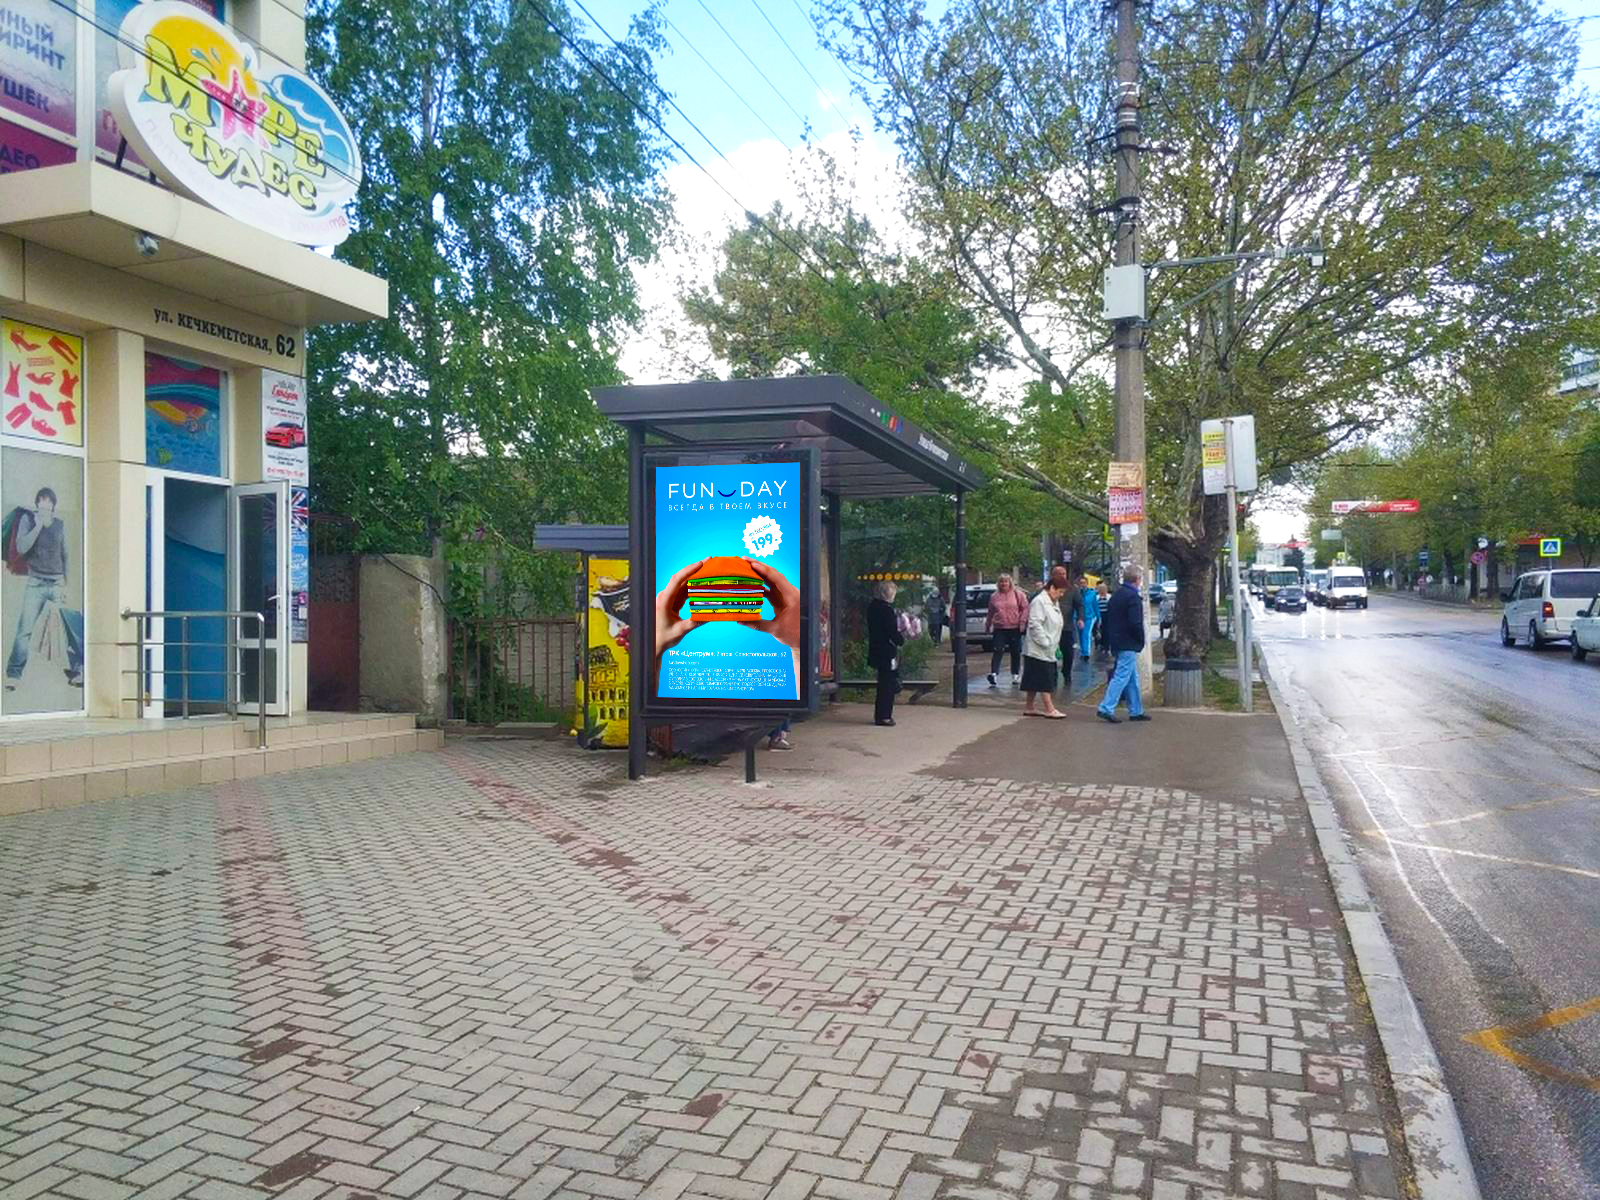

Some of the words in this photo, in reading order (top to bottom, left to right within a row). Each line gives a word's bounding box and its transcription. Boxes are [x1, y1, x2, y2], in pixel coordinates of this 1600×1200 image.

[0, 75, 49, 113] ШЕК
[171, 113, 317, 211] ЧУДЕС
[153, 308, 174, 324] ул.
[177, 313, 273, 355] КЕЧКЕМЕТСКАЯ,
[276, 334, 296, 358] 62
[668, 482, 714, 499] FUN
[740, 480, 788, 497] DAY
[668, 503, 705, 512] ВСЕГДА
[757, 501, 788, 509] ВКУСЕ
[668, 649, 680, 657] ТРК
